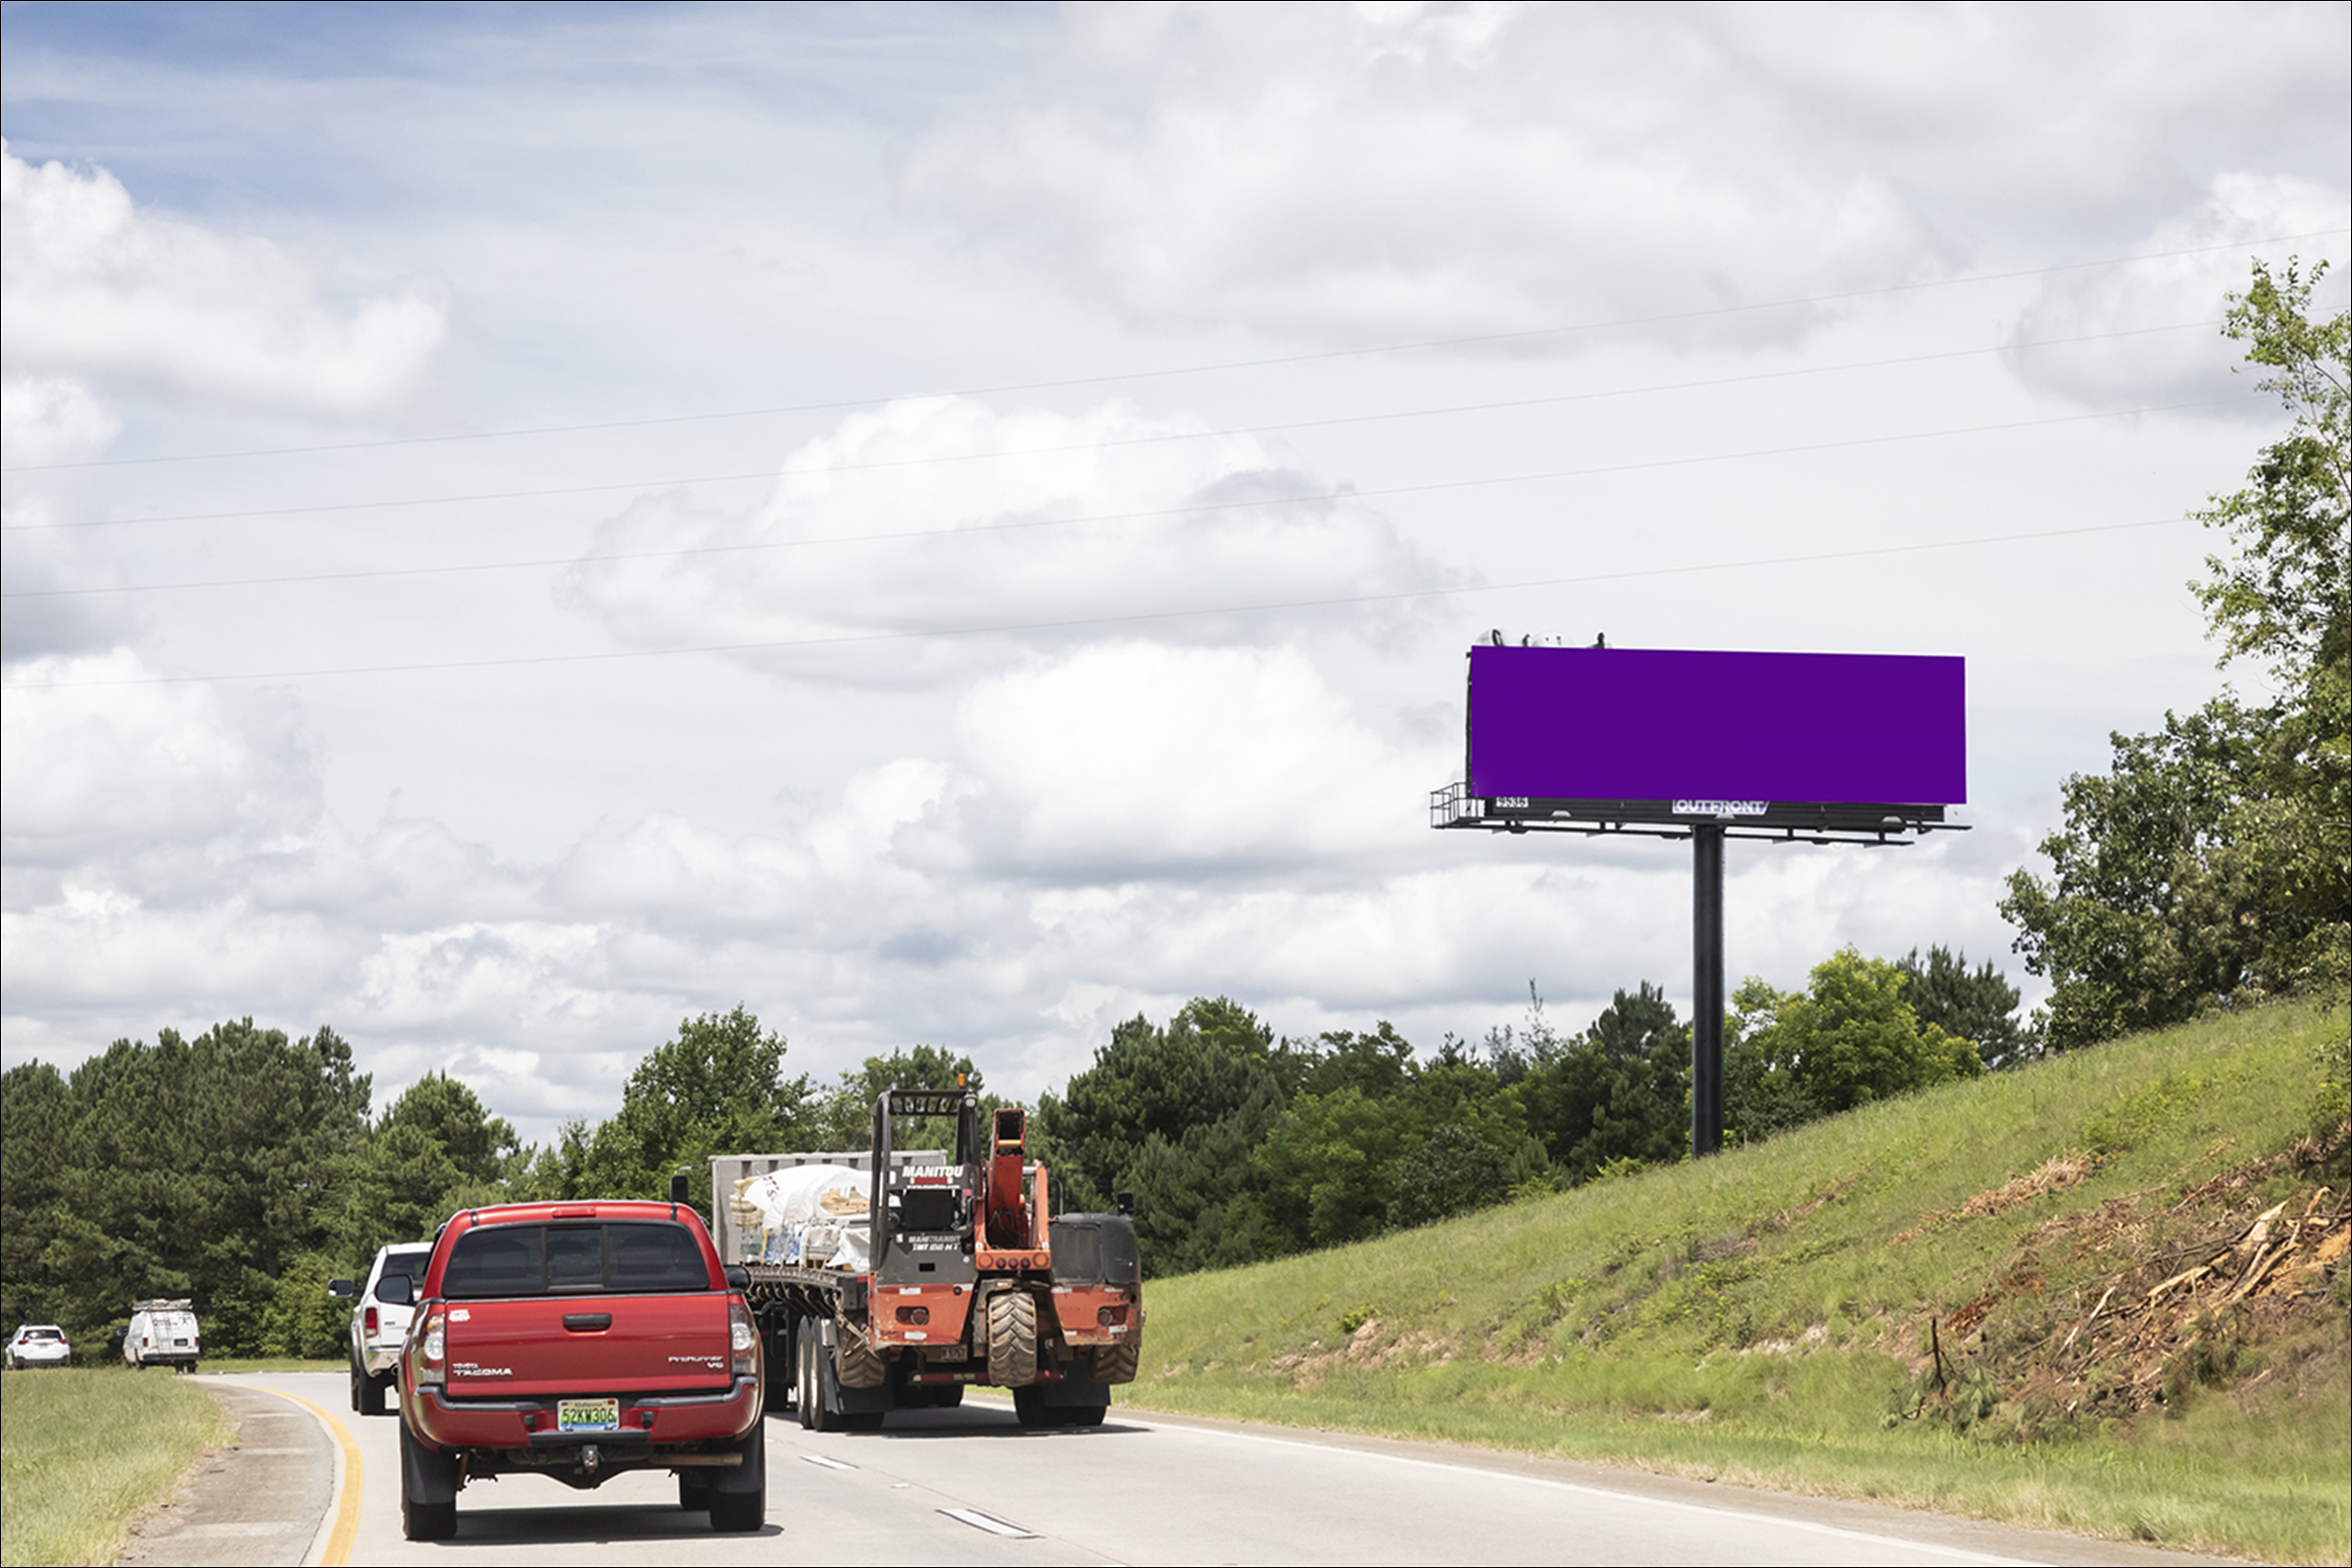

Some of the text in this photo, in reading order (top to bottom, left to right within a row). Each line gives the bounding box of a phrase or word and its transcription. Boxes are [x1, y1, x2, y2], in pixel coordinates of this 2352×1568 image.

[1677, 800, 1765, 812] OUTFRONT
[902, 1165, 964, 1177] MANITOU
[453, 1368, 514, 1377] TACOMA
[562, 1407, 614, 1424] 52KW306
